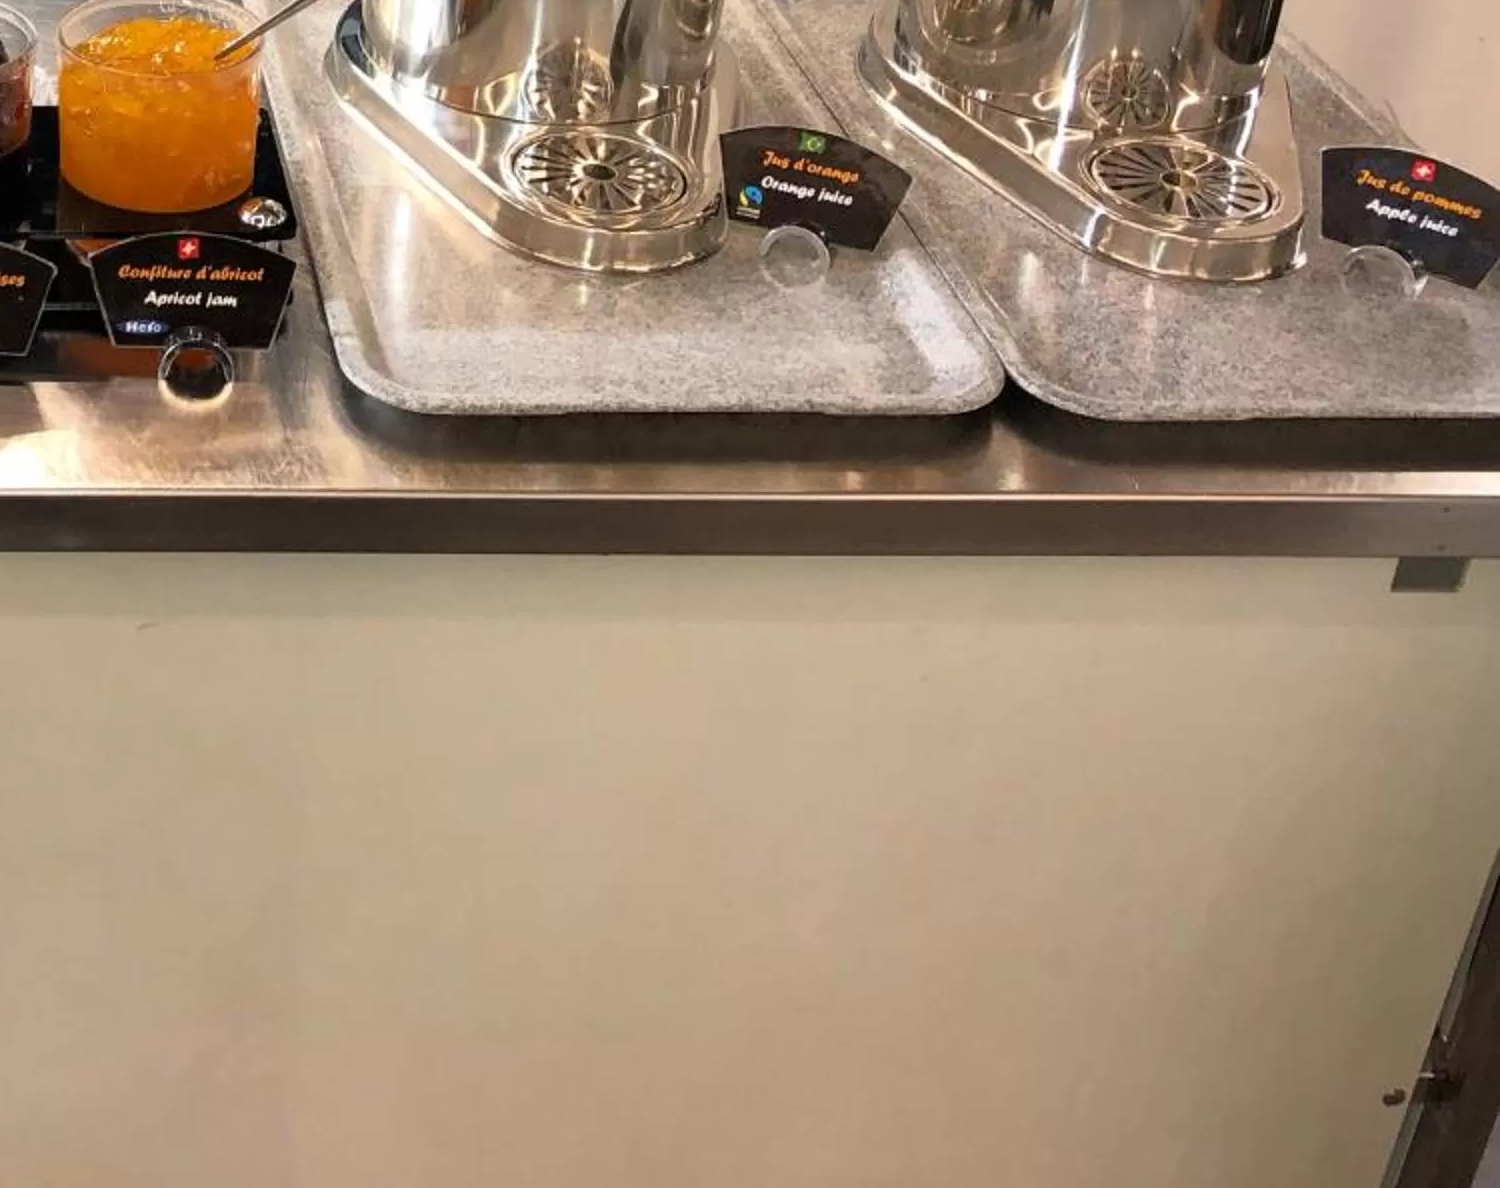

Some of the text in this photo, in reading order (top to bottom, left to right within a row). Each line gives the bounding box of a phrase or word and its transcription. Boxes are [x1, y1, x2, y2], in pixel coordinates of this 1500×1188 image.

[761, 175, 854, 207] Orange juice
[1365, 198, 1459, 237] Apple juice
[117, 263, 192, 282] Confiture
[143, 288, 238, 308] Apricot jam
